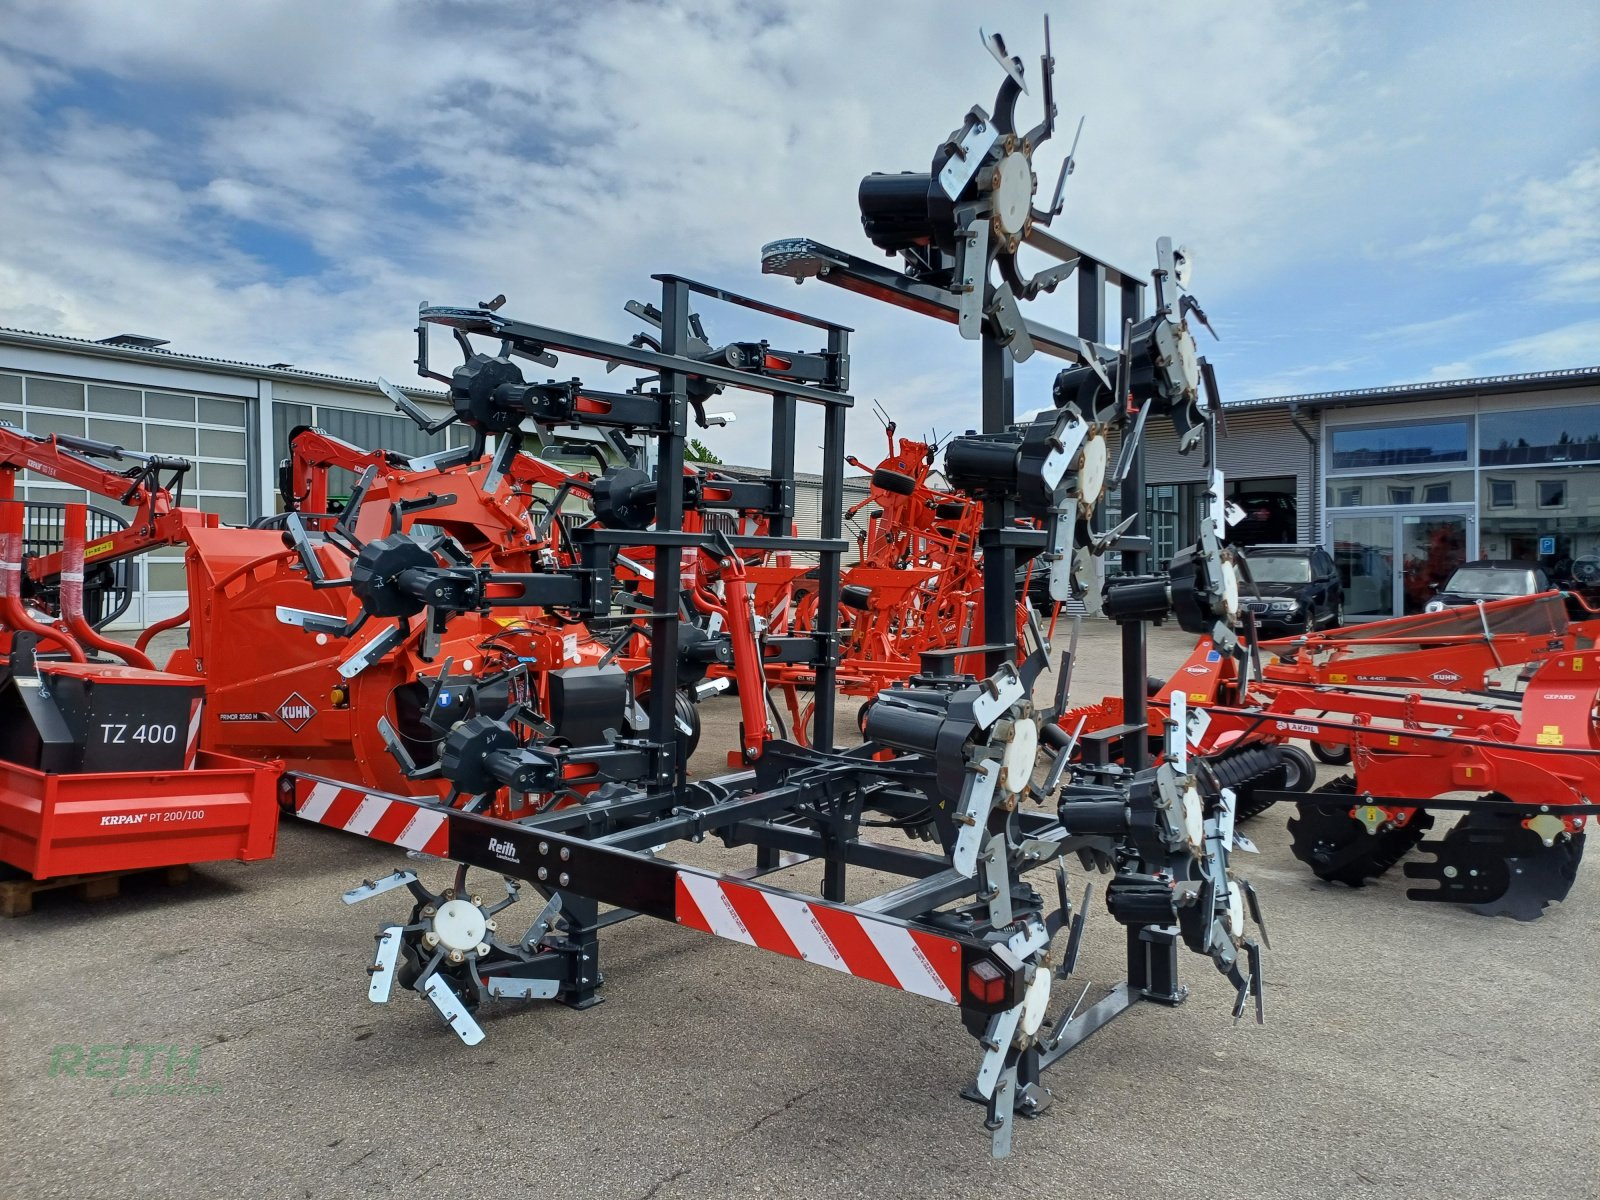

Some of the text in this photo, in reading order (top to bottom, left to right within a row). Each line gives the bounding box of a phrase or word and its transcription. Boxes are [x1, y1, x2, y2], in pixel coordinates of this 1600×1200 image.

[492, 411, 507, 422] 17
[617, 505, 629, 517] 17
[282, 706, 310, 719] KUHN
[100, 724, 177, 744] TZ 400
[1291, 724, 1316, 732] AKPIL
[149, 812, 162, 822] PT
[163, 810, 205, 822] 200/100
[488, 837, 516, 857] Reith
